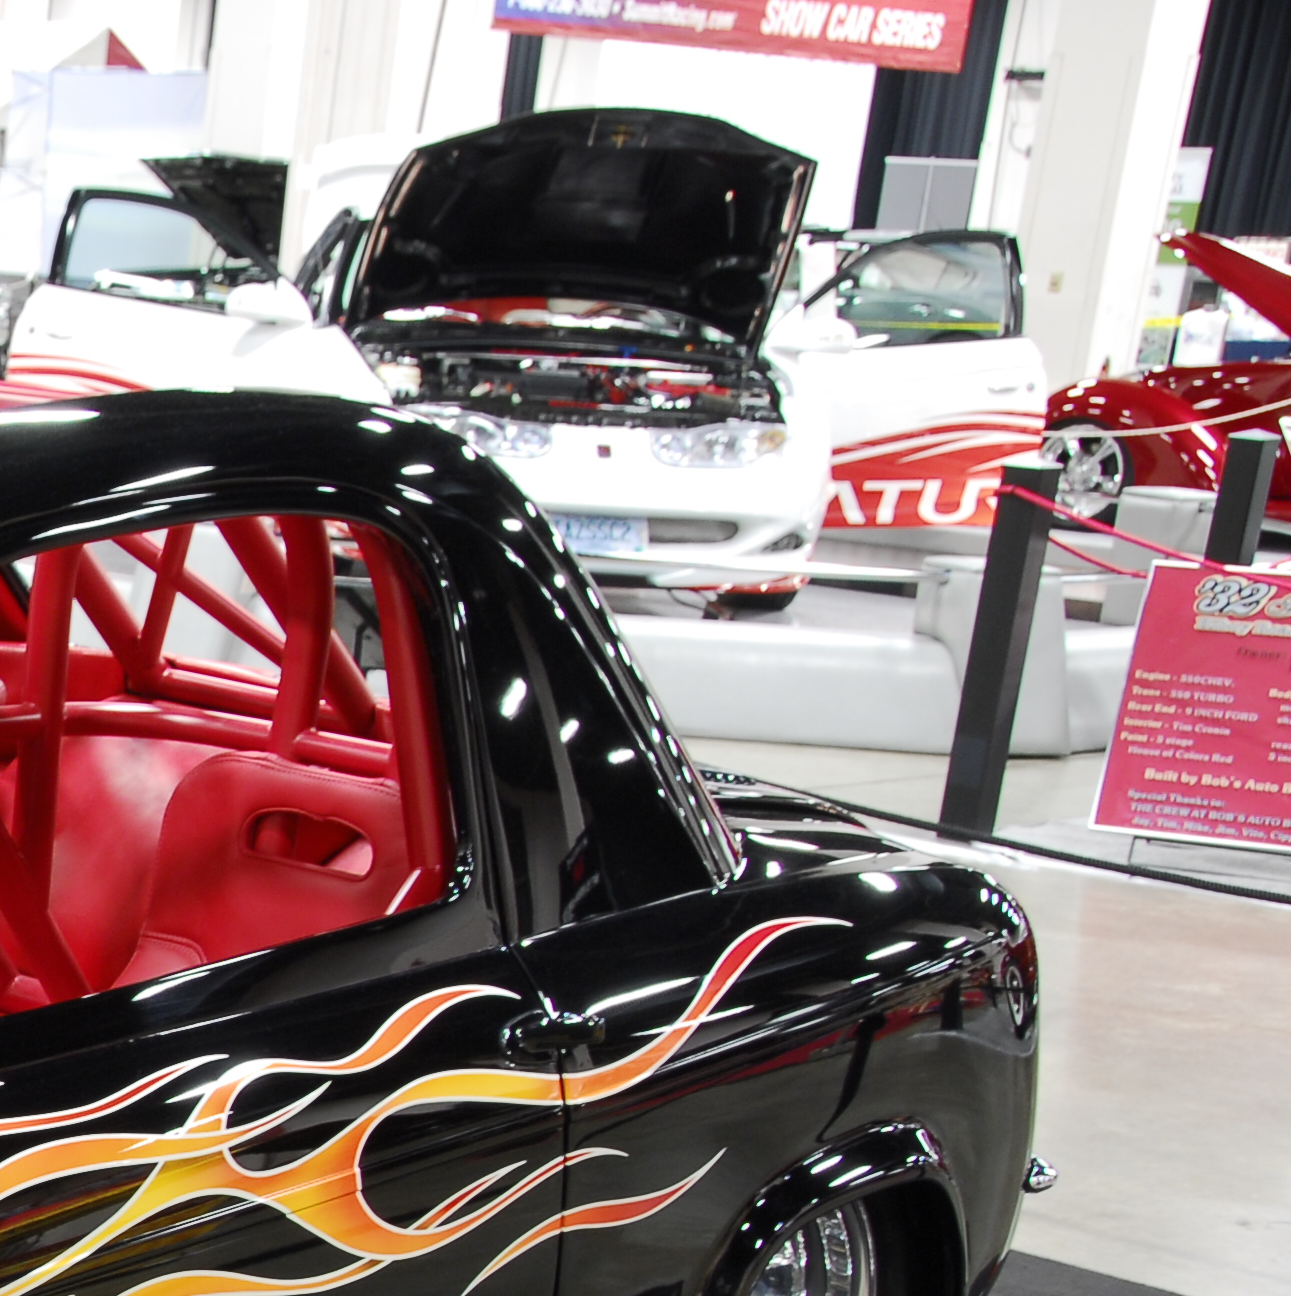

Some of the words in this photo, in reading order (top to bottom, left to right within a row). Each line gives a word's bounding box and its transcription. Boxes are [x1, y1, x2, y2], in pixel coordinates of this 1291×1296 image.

[760, 0, 830, 39] SHOW
[826, 3, 875, 44] CAR
[872, 7, 946, 51] SERIES
[1193, 690, 1235, 704] TURBO
[1154, 703, 1177, 714] End
[1225, 710, 1259, 722] FORD
[1161, 748, 1175, 758] of
[1211, 752, 1235, 764] Red
[1144, 767, 1179, 783] Built
[1180, 772, 1199, 786] by
[1200, 773, 1242, 789] Bob's
[1244, 778, 1280, 793] Auto
[1169, 793, 1209, 806] Thanks
[1130, 802, 1154, 813] THE
[1155, 804, 1190, 818] CREW
[1191, 809, 1208, 819] AT
[1247, 815, 1281, 827] AUTO
